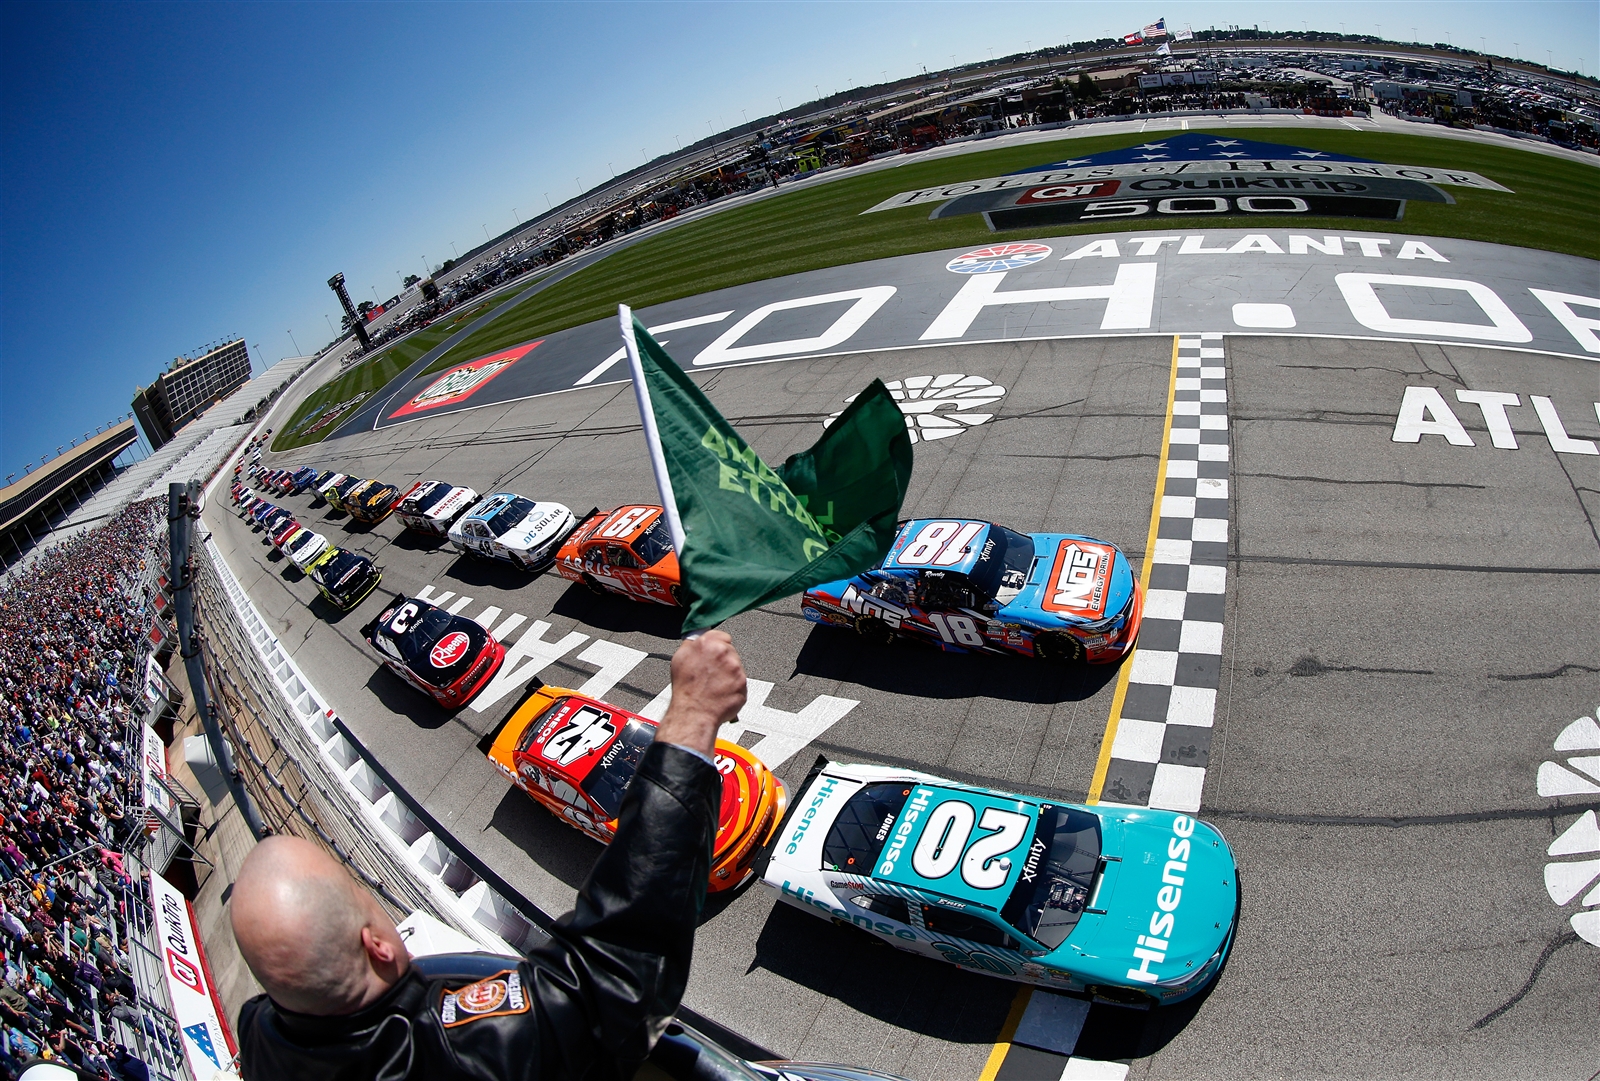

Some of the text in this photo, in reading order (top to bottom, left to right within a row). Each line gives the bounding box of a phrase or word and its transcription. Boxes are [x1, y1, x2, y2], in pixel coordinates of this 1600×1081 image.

[904, 161, 1482, 204] FOLDS of HONOR
[1031, 176, 1369, 199] QT QuikTrip
[1078, 196, 1309, 220] 500
[1059, 234, 1452, 263] ATLANTA
[523, 530, 537, 545] DC
[536, 508, 564, 532] SOLAR
[601, 507, 659, 538] 19
[644, 518, 662, 536] xfinity
[897, 521, 986, 567] 18
[980, 538, 996, 562] xfinity
[563, 554, 613, 578] ARRIS
[1052, 543, 1099, 609] NOS
[1091, 552, 1110, 611] ENERGY DRINK
[390, 602, 419, 634] 3
[840, 583, 911, 629] NOS
[408, 617, 424, 633] xfinity
[926, 611, 986, 648] 18
[431, 634, 468, 667] Rheem
[536, 706, 571, 744] ENEOS
[541, 704, 616, 767] 42
[600, 740, 625, 769] xfinity
[488, 755, 528, 792] ENEOS
[563, 805, 596, 831] 42
[785, 778, 839, 855] Hisense
[876, 813, 895, 841] JONES
[879, 788, 934, 876] Hisense
[911, 799, 1032, 891] 20
[1021, 838, 1047, 883] xfinity
[830, 880, 864, 890] GameStop
[1126, 813, 1196, 985] Hisense
[781, 879, 917, 943] Hisense
[161, 893, 199, 988] QT QuikTrip
[931, 940, 1018, 977] 20
